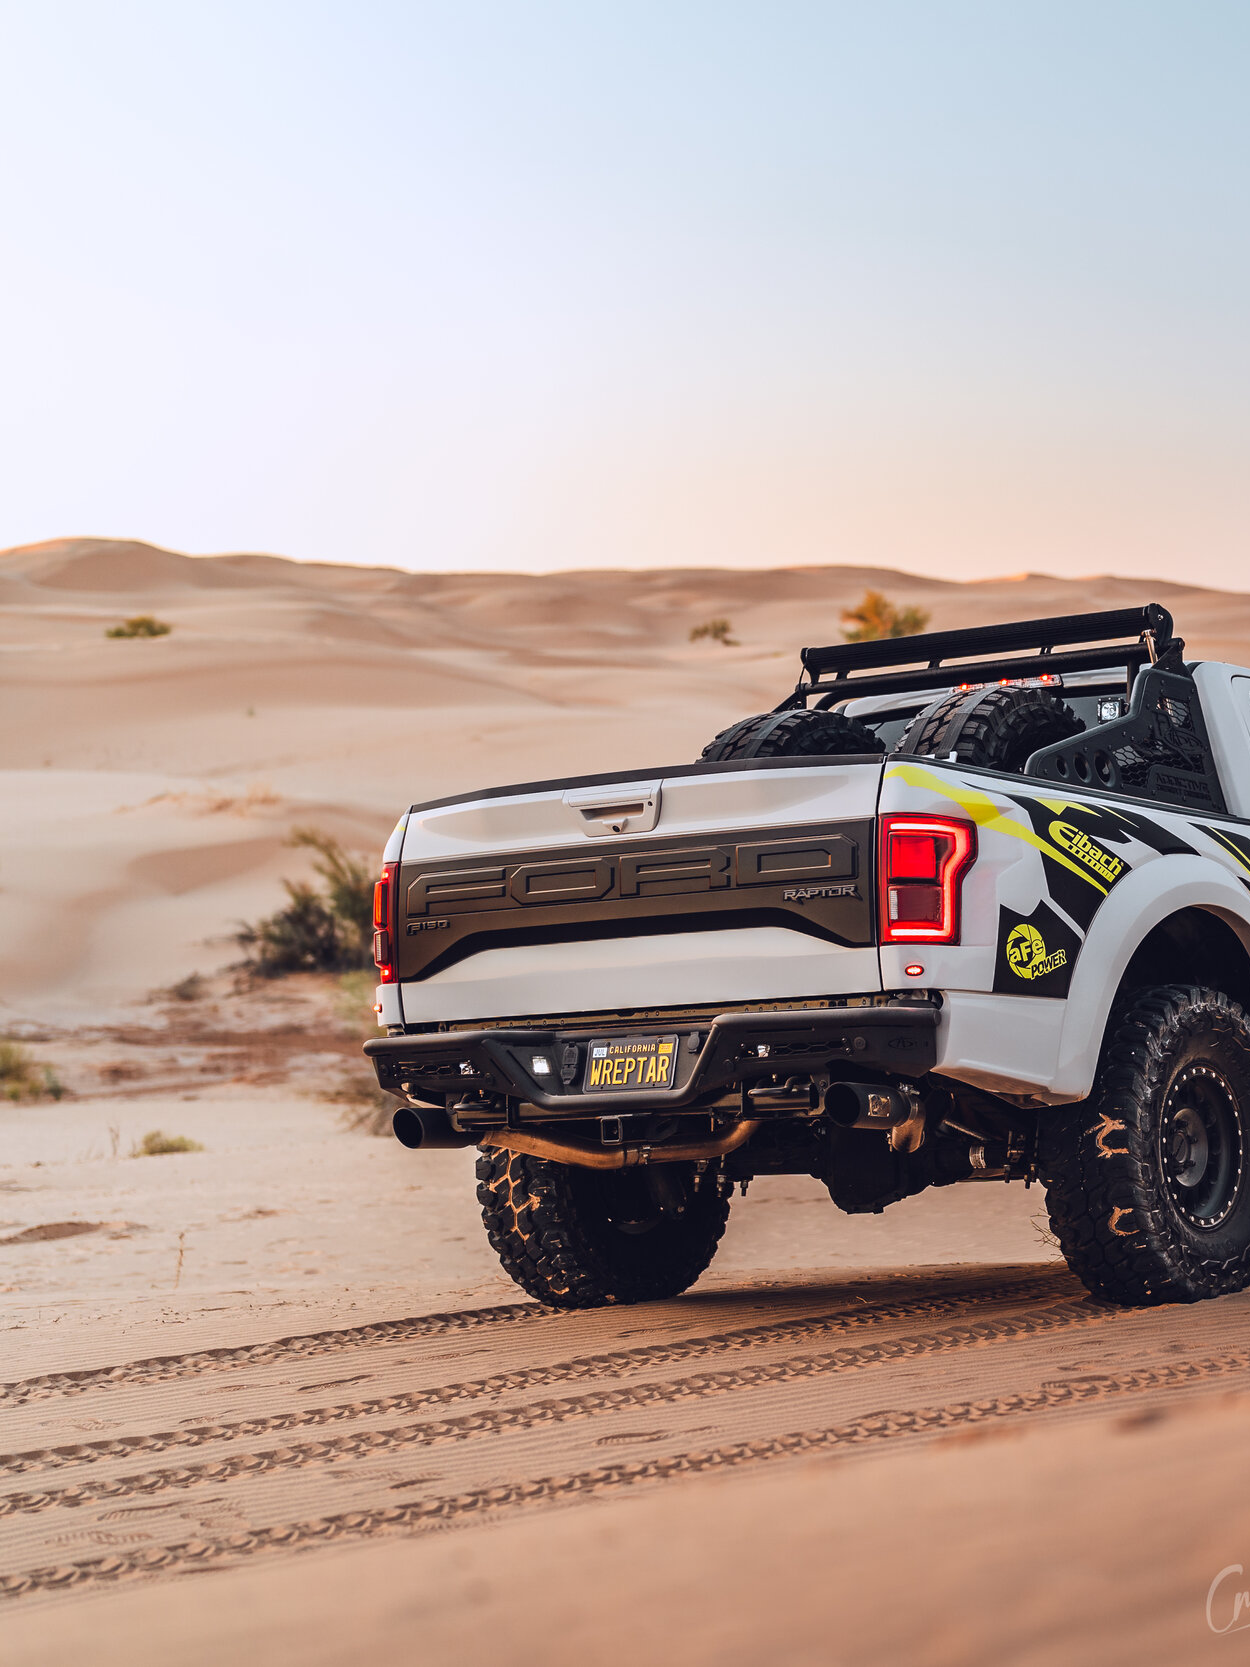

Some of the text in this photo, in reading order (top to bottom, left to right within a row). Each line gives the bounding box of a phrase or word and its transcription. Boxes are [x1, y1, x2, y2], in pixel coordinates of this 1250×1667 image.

[1048, 820, 1124, 877] Eibach
[407, 833, 858, 918] FORD
[783, 884, 862, 904] RAPTOR
[407, 920, 449, 936] F150
[1009, 939, 1044, 963] aFe
[1030, 949, 1067, 980] POWER
[609, 1043, 656, 1054] CALIFORNIA
[590, 1055, 669, 1086] WREPTAR
